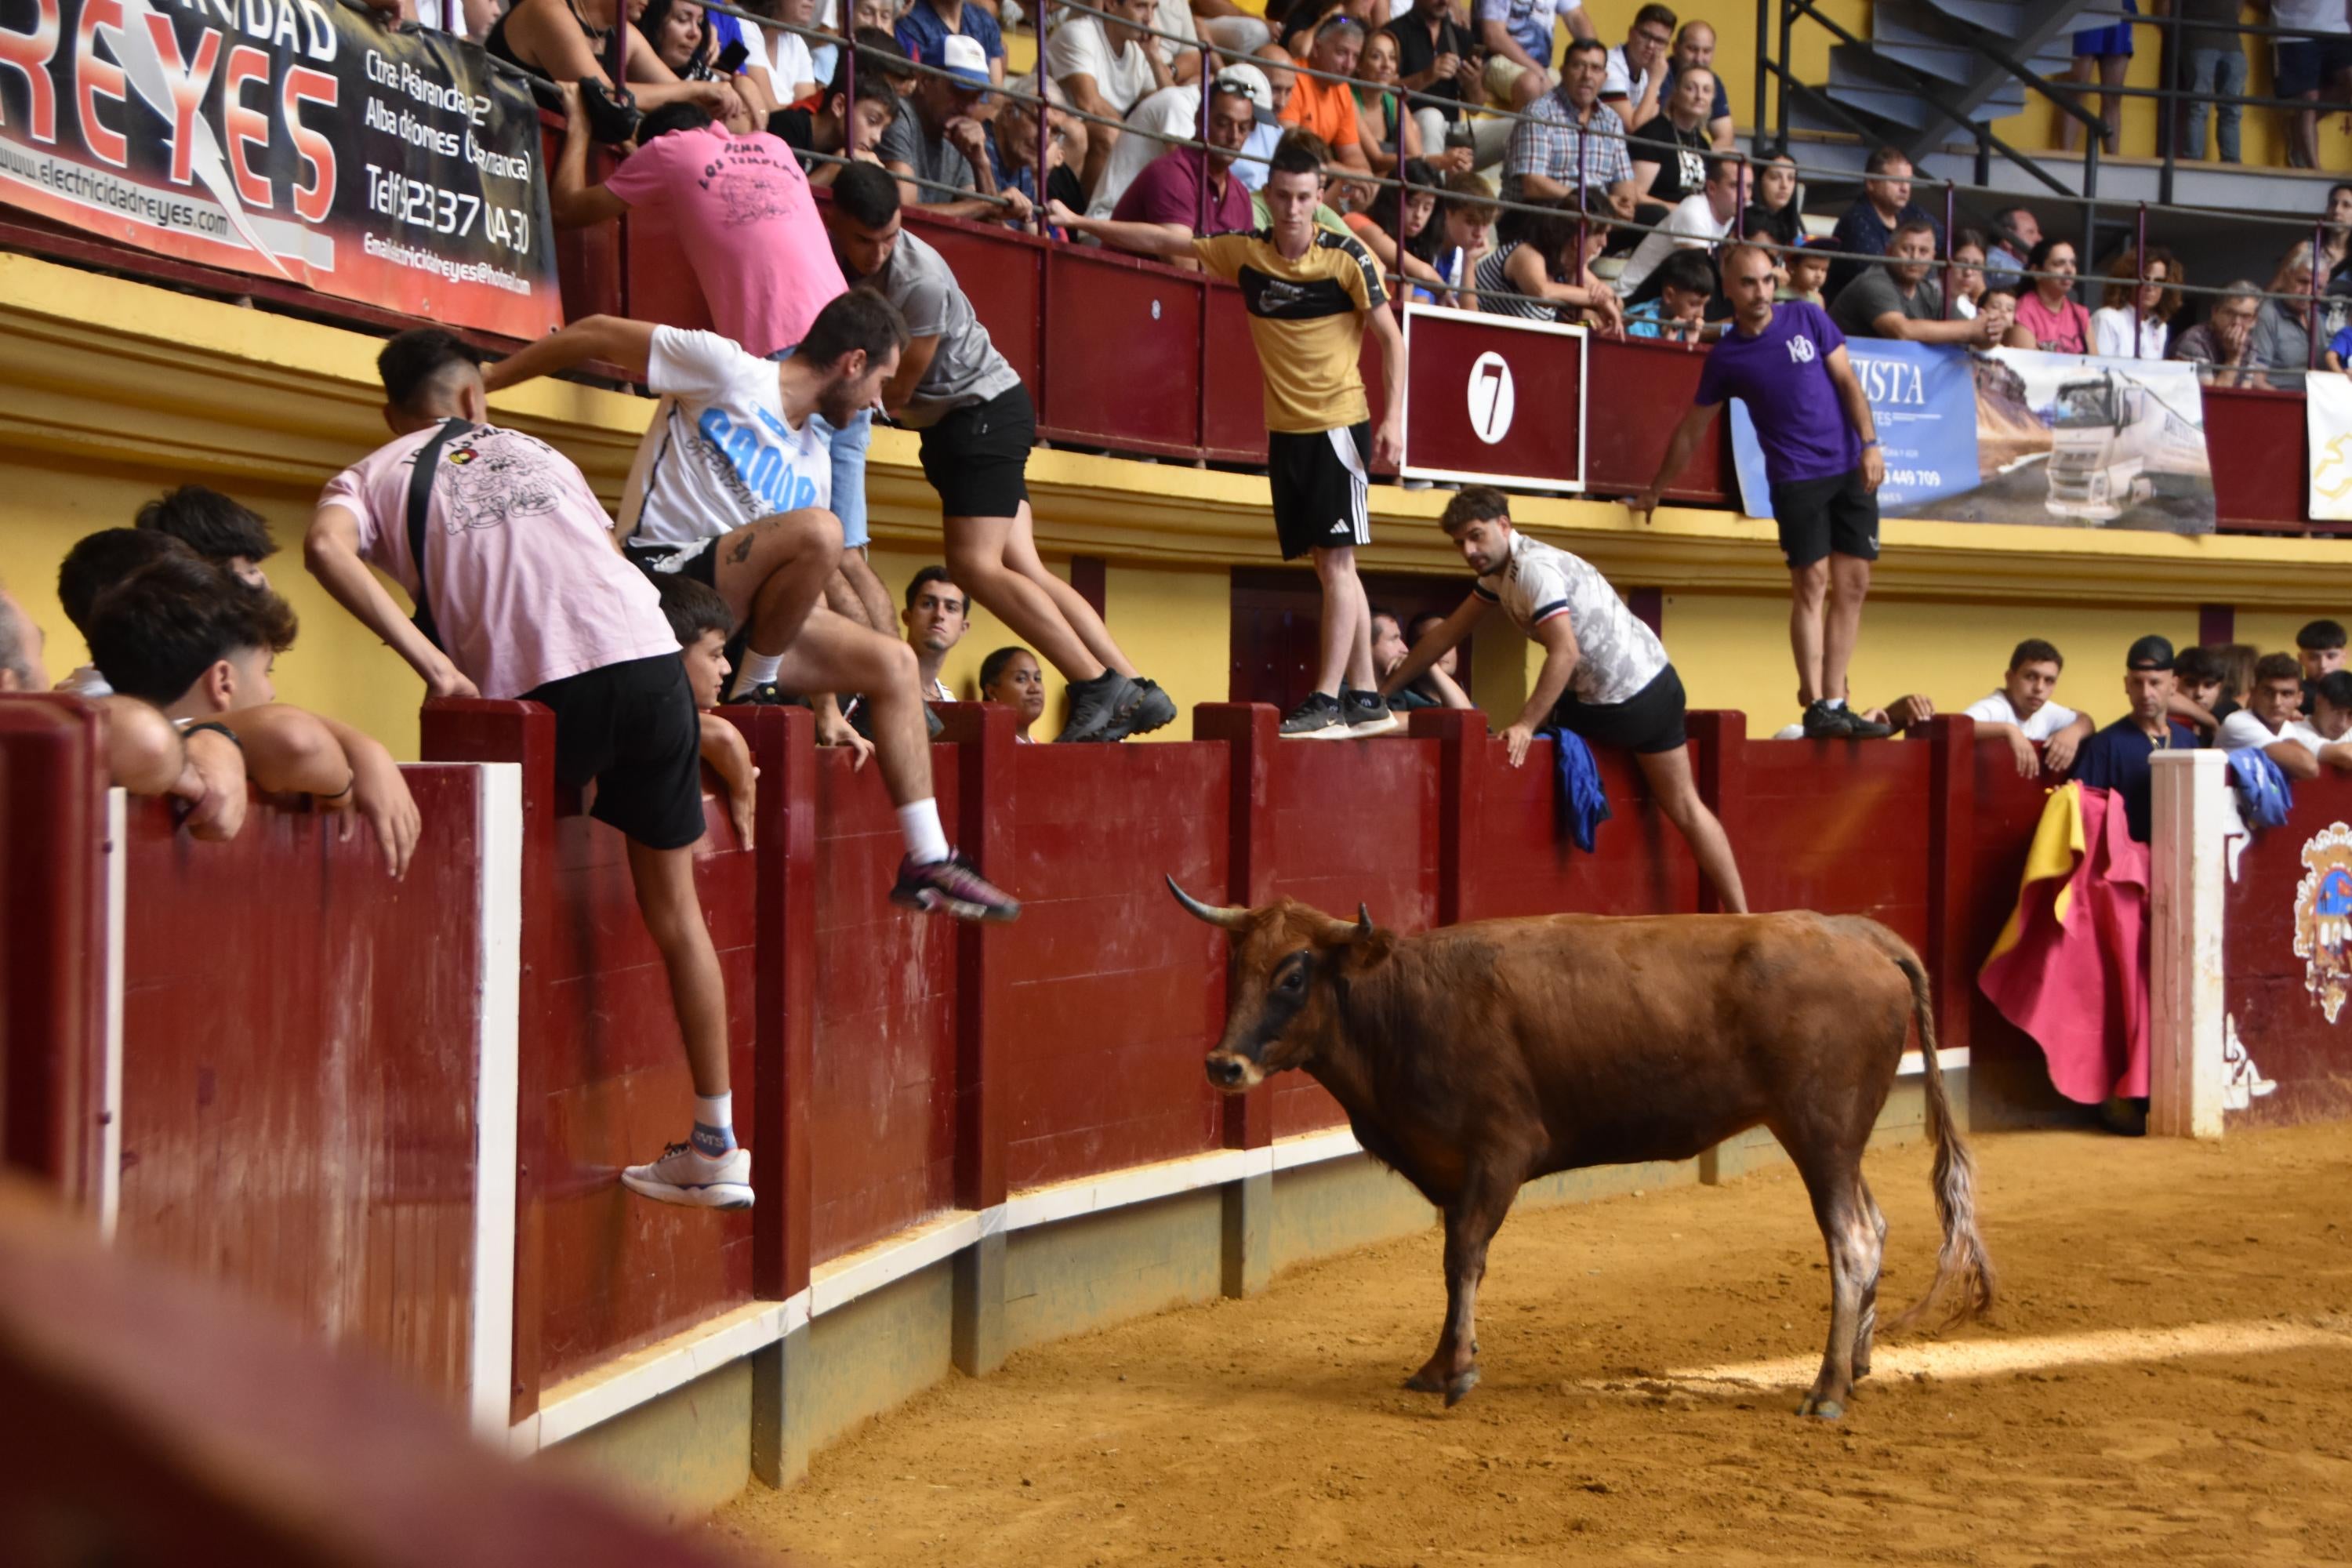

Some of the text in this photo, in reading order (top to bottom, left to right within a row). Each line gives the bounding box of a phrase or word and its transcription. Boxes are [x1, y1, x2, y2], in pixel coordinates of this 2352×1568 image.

[0, 0, 339, 223] REYES
[365, 96, 397, 136] Alba
[1481, 362, 1504, 436] 7
